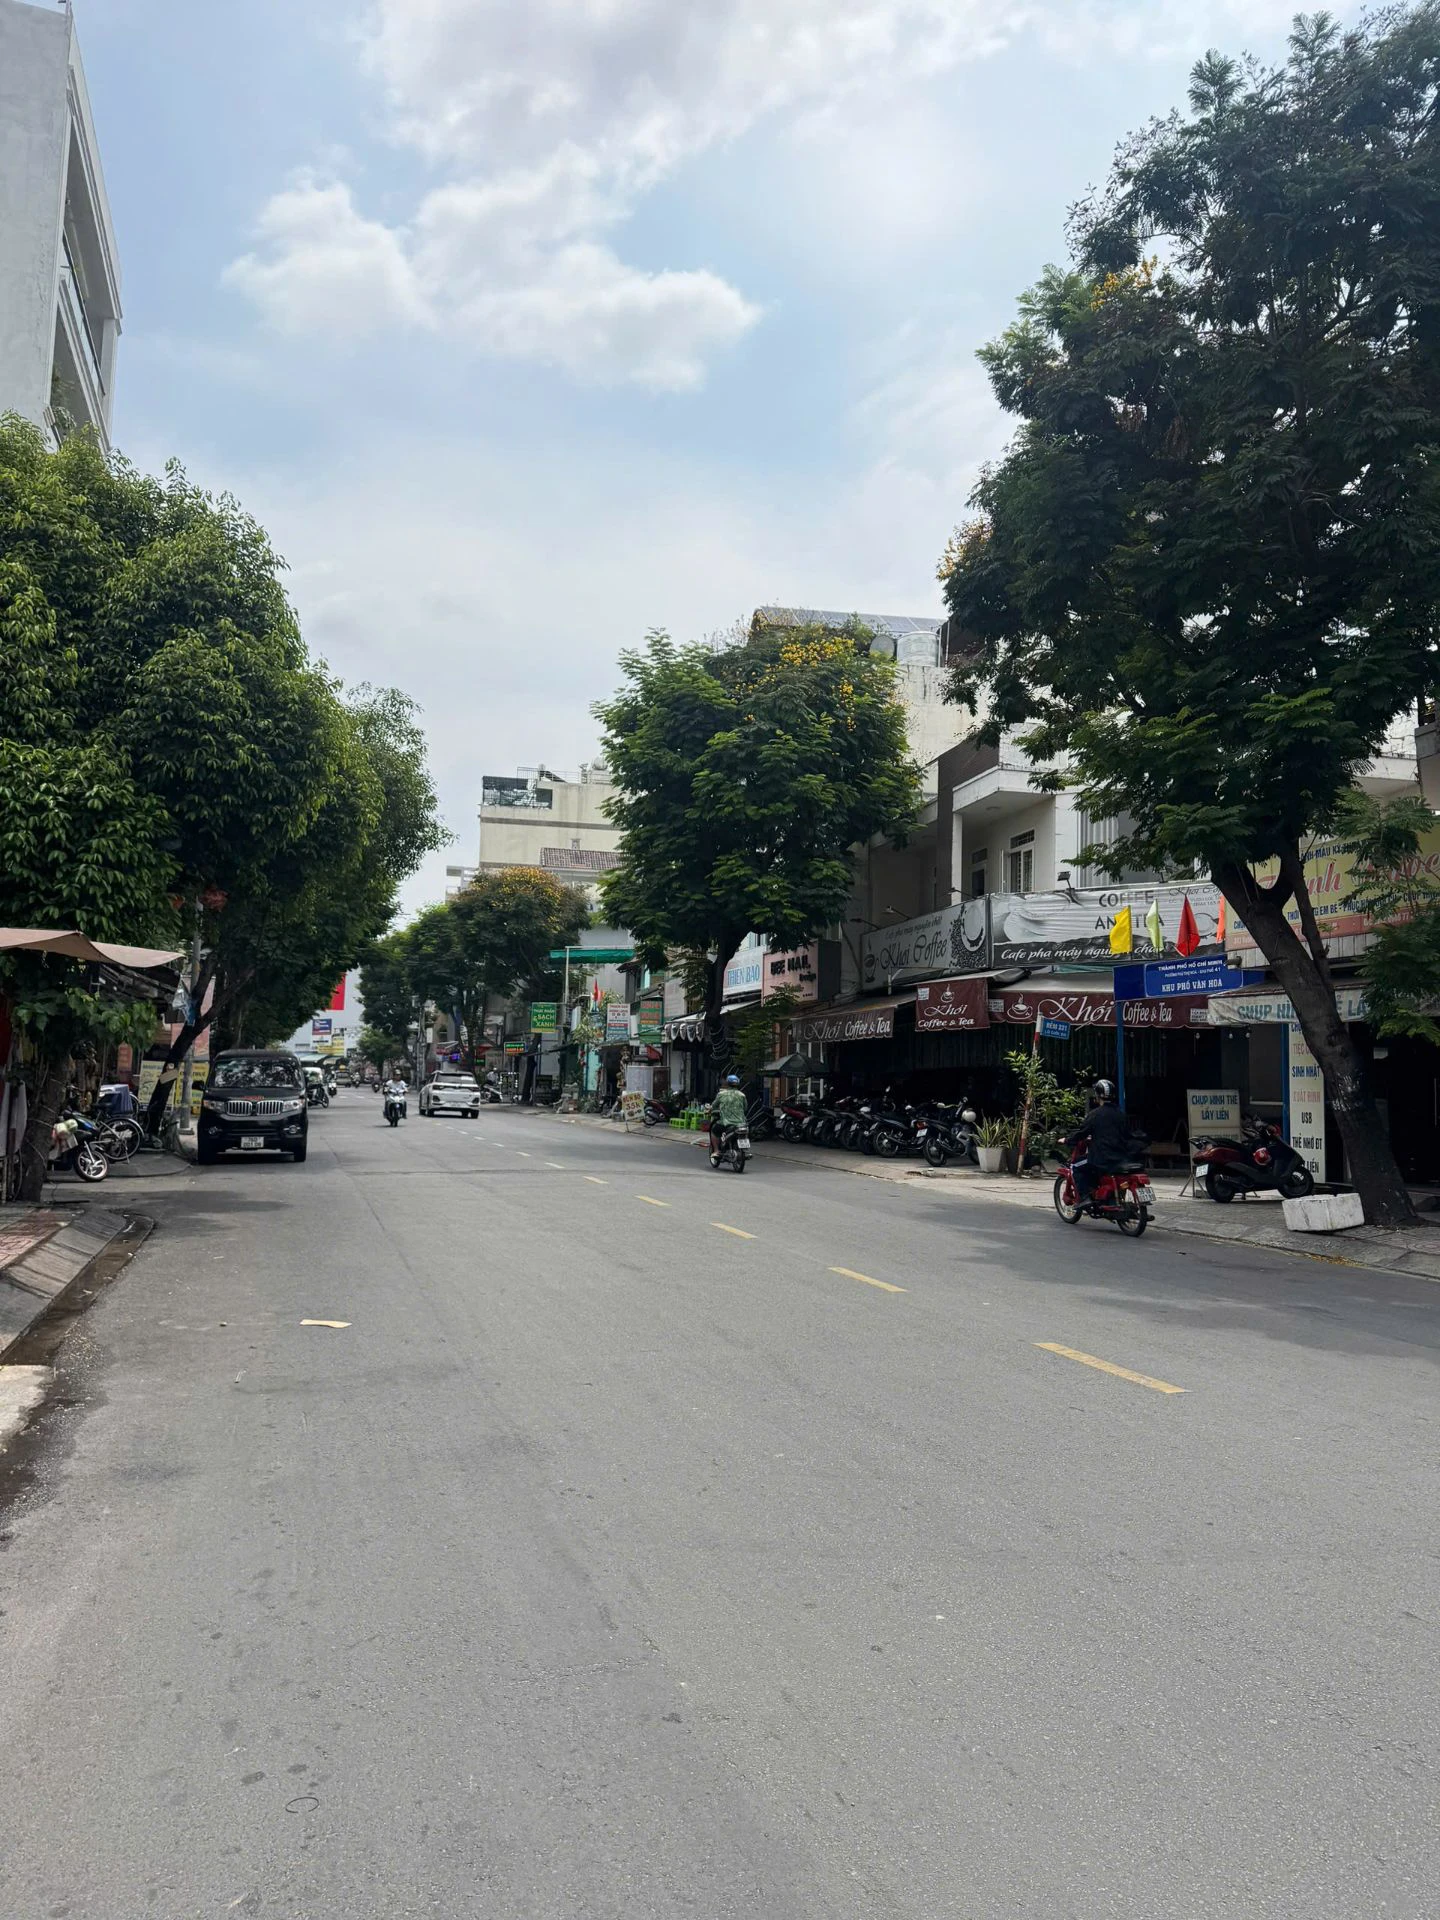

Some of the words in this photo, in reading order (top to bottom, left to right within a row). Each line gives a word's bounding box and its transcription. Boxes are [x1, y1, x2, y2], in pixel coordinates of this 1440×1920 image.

[1001, 948, 1027, 960] Cafe
[1029, 948, 1050, 962] pha
[1053, 946, 1083, 962] máy
[1162, 983, 1175, 992] KHU
[1122, 1001, 1149, 1023] Coffee
[1151, 1009, 1157, 1020] &
[1158, 1002, 1172, 1022] Tea
[845, 1021, 866, 1038] Coffee
[876, 1017, 891, 1033] Tea
[918, 1018, 947, 1028] Coffee
[958, 1017, 975, 1026] Tea
[1292, 1066, 1305, 1078] SINH
[1301, 1112, 1312, 1124] USB
